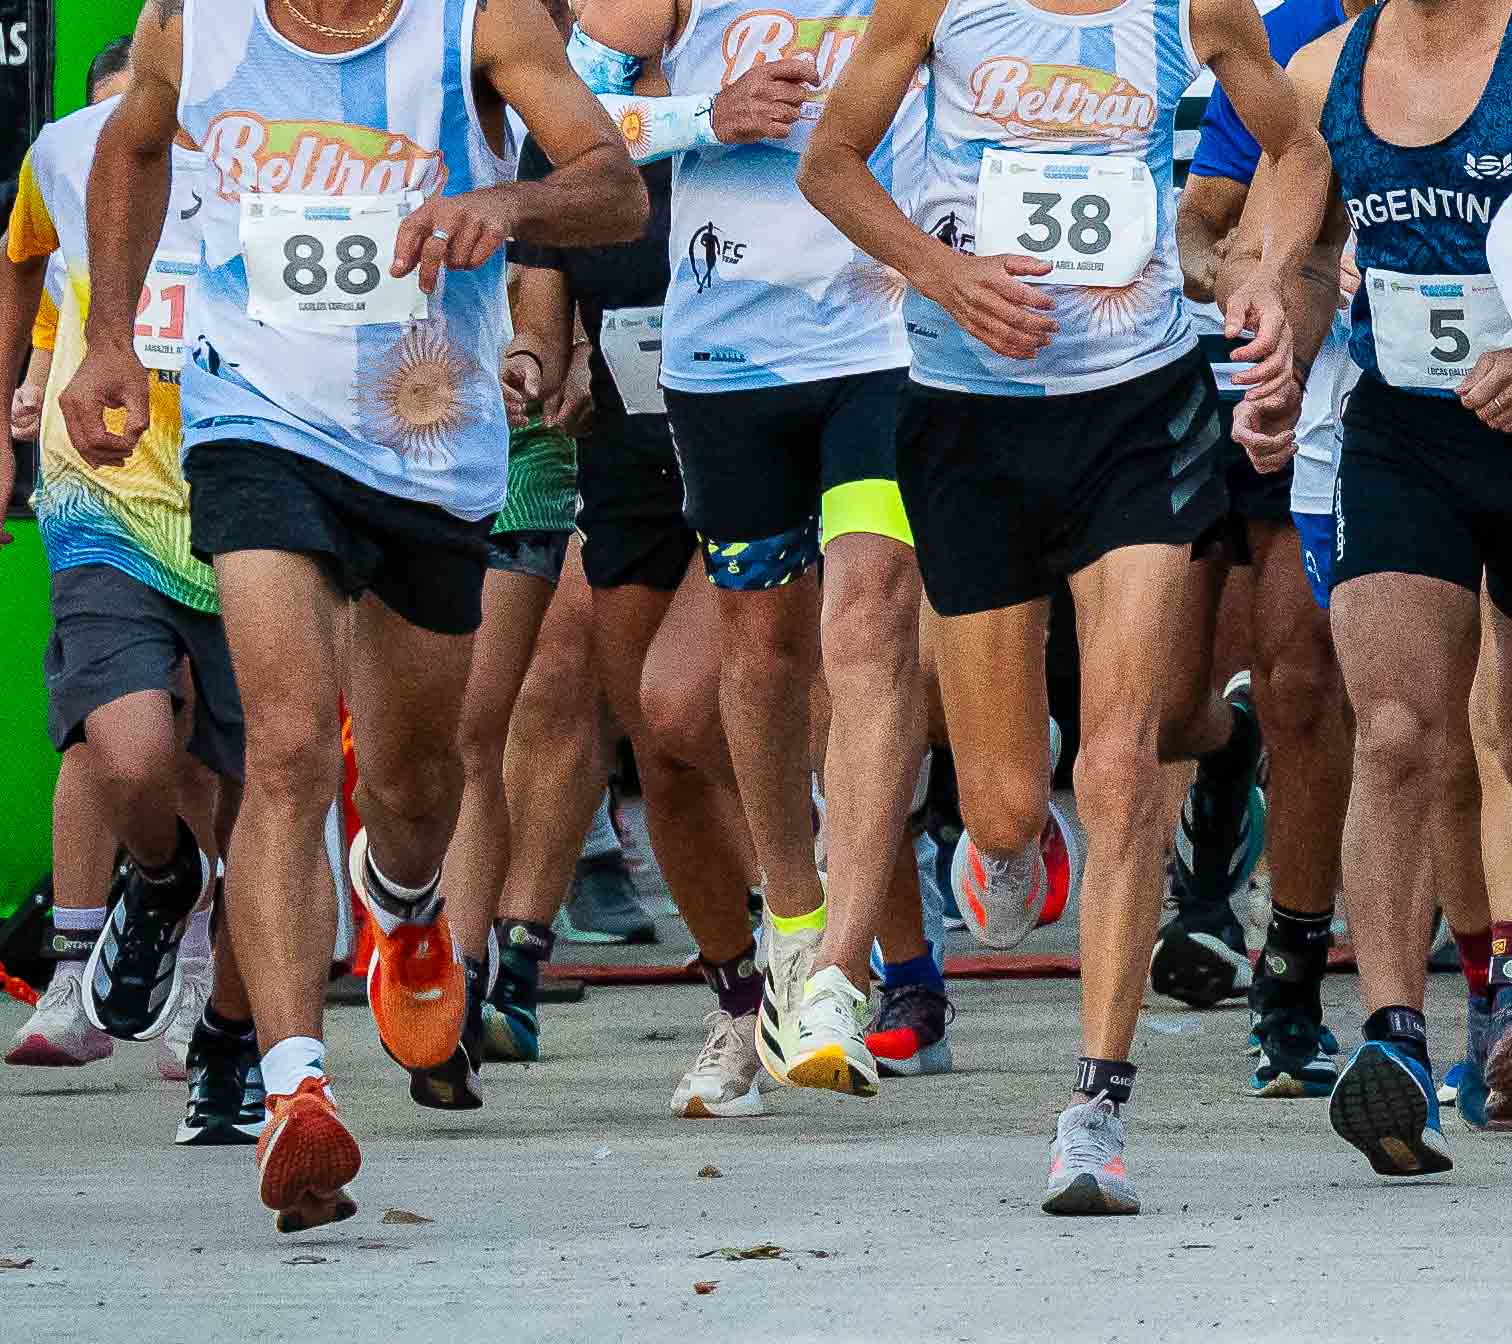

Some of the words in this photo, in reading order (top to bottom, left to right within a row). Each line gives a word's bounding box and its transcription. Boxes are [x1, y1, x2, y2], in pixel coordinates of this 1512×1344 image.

[972, 57, 1154, 128] Beltrán
[722, 240, 747, 259] FC
[1017, 191, 1111, 255] 38
[283, 234, 380, 296] 88
[1430, 309, 1471, 363] 5
